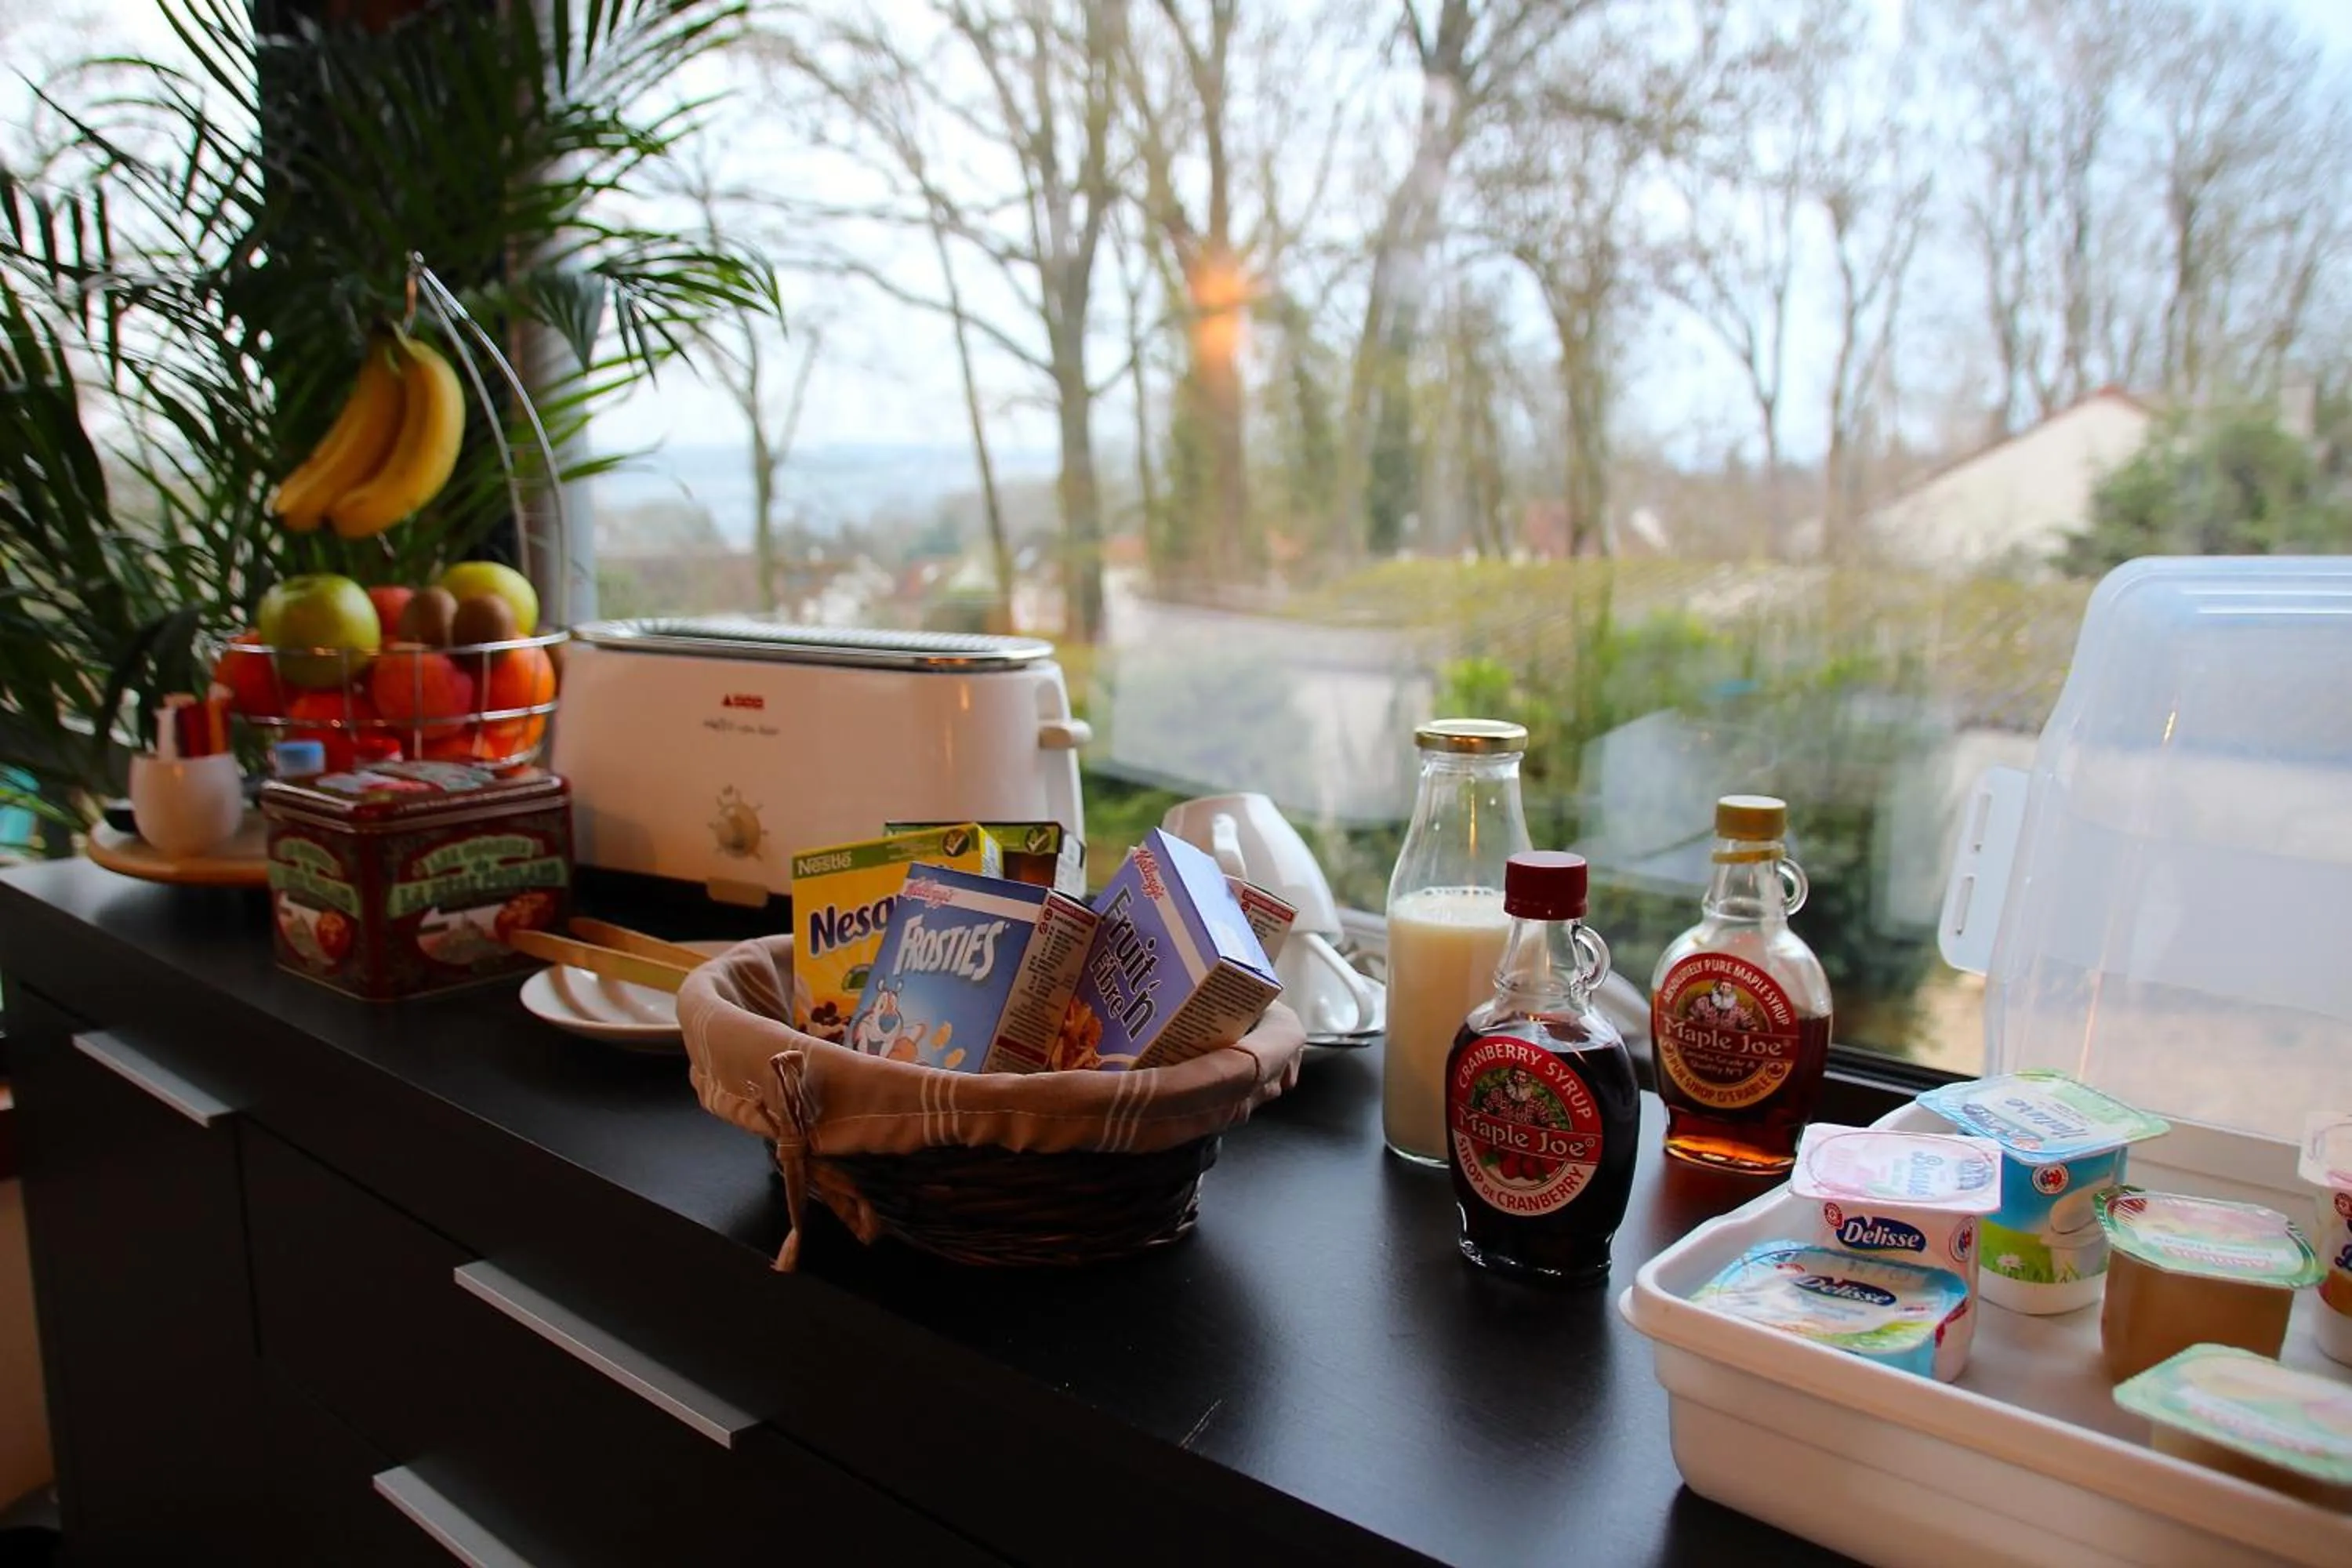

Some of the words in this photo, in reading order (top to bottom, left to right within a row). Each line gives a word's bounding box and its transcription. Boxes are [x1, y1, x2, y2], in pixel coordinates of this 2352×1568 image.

[810, 895, 900, 954] Nesq
[1090, 946, 1126, 1019] Fibre
[1704, 959, 1732, 974] PURE
[1734, 966, 1769, 996] MAPLE
[1764, 990, 1791, 1025] SYRUP
[1664, 1017, 1732, 1049] Maple
[1459, 1044, 1542, 1088] CRANBERRY
[1544, 1062, 1592, 1119] SYRUP
[1459, 1106, 1529, 1149] Maple
[1457, 1134, 1483, 1188] SIROP
[1497, 1166, 1585, 1211] CRANBERRY
